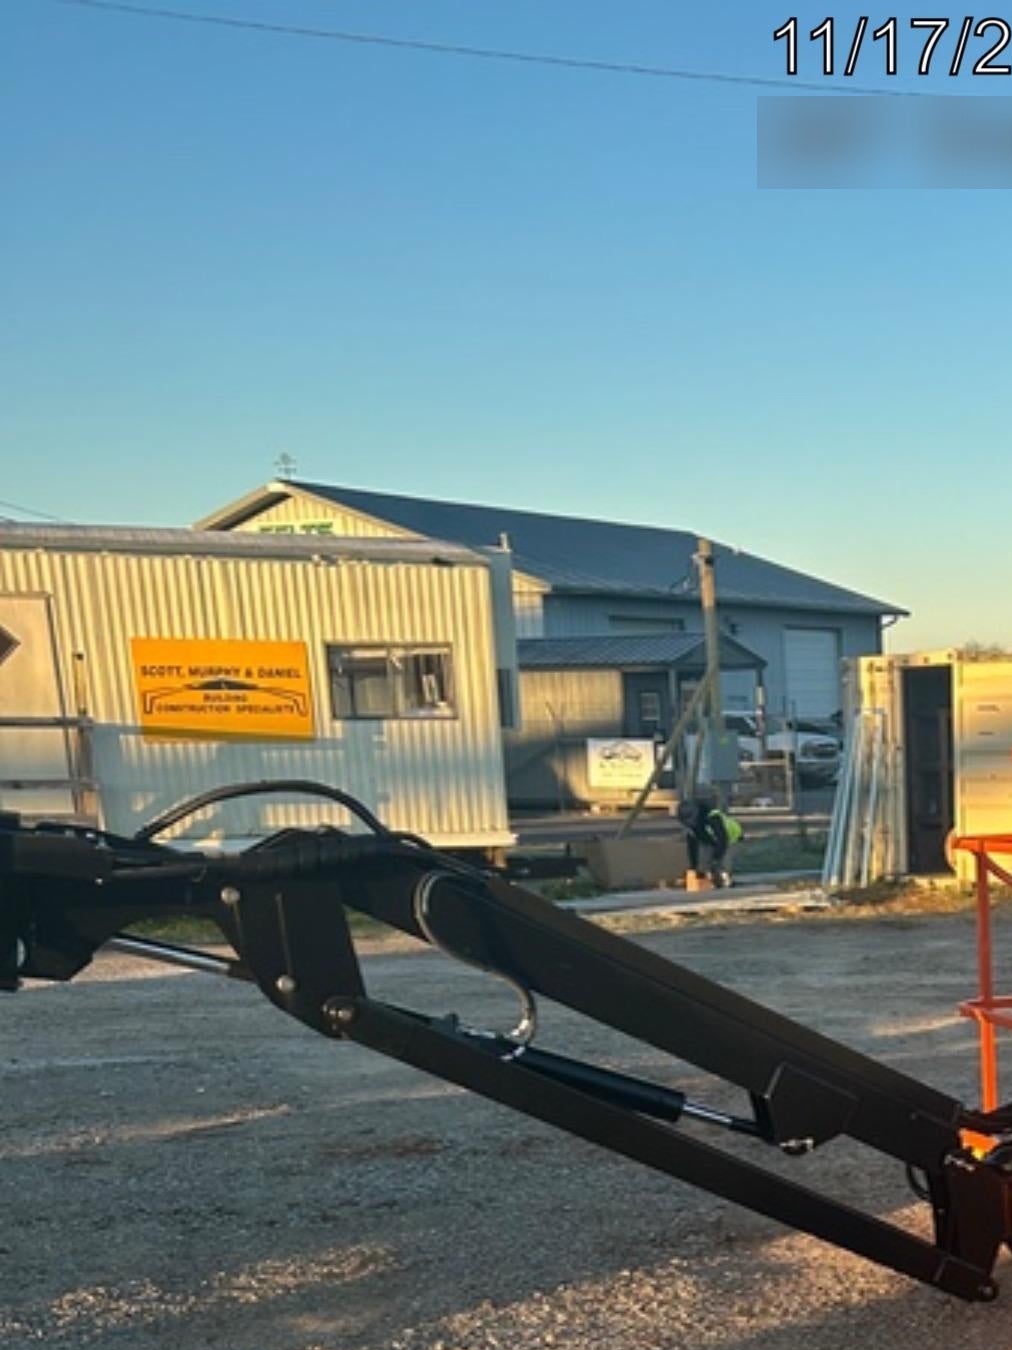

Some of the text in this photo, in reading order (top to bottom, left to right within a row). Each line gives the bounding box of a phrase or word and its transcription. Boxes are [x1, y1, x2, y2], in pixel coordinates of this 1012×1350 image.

[140, 665, 302, 679] SCOTT, MURPHY & DANIEL
